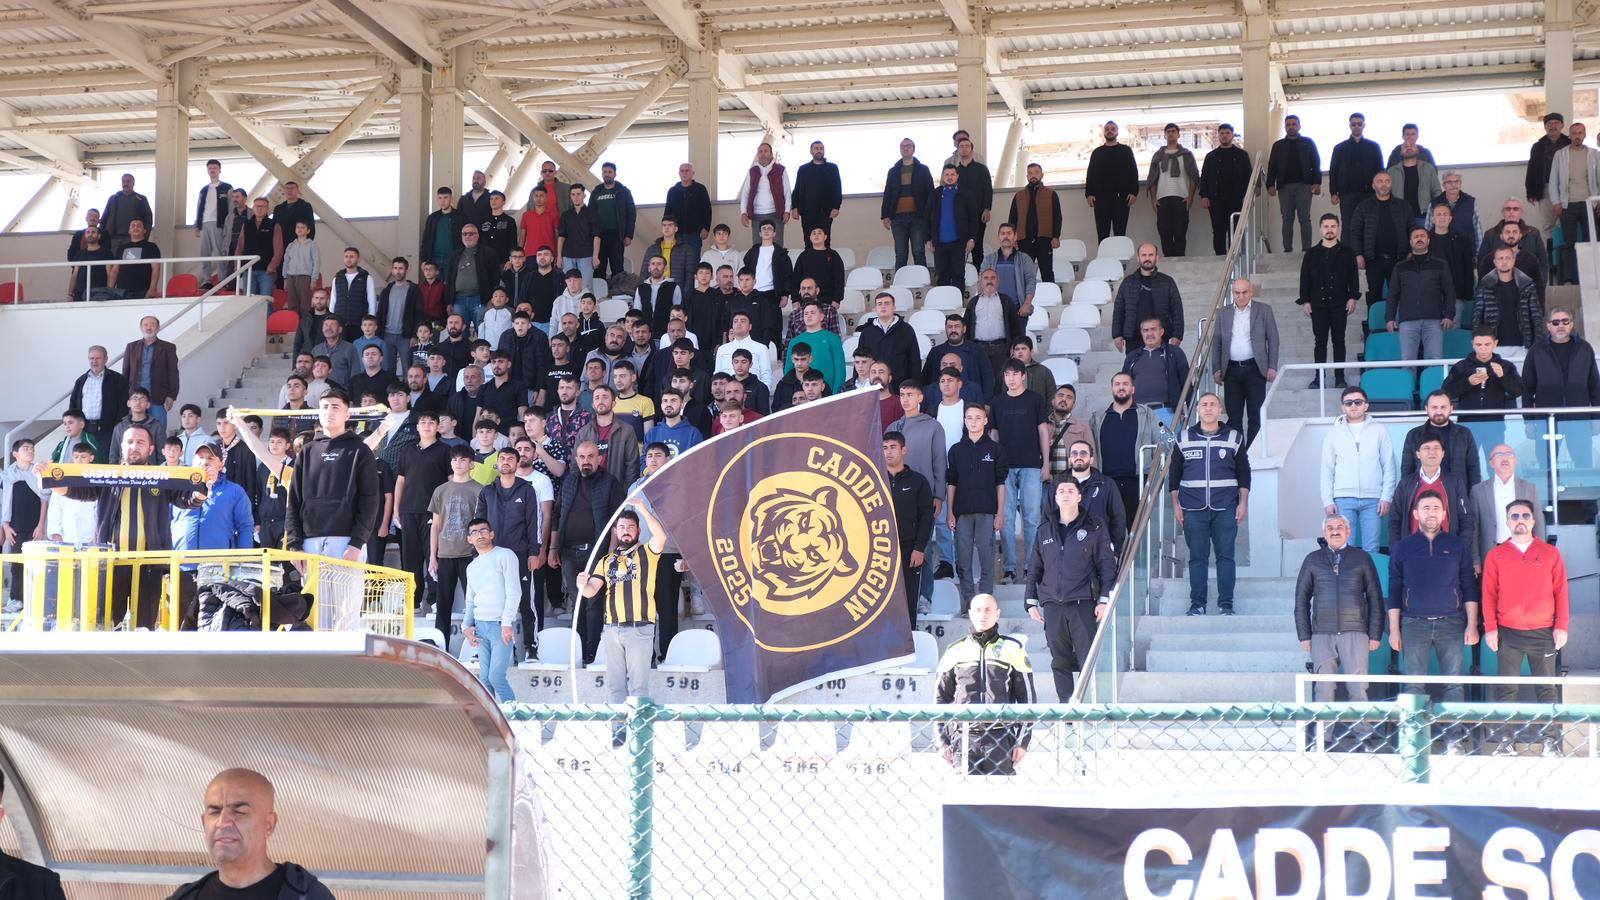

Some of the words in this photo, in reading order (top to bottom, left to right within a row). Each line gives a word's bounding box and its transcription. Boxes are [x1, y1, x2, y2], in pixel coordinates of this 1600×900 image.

[807, 446, 884, 513] CADDE
[715, 538, 753, 607] 2025
[843, 519, 893, 622] SORGUN
[530, 675, 563, 688] 596
[666, 676, 700, 691] 598
[1123, 826, 1452, 900] CADDE
